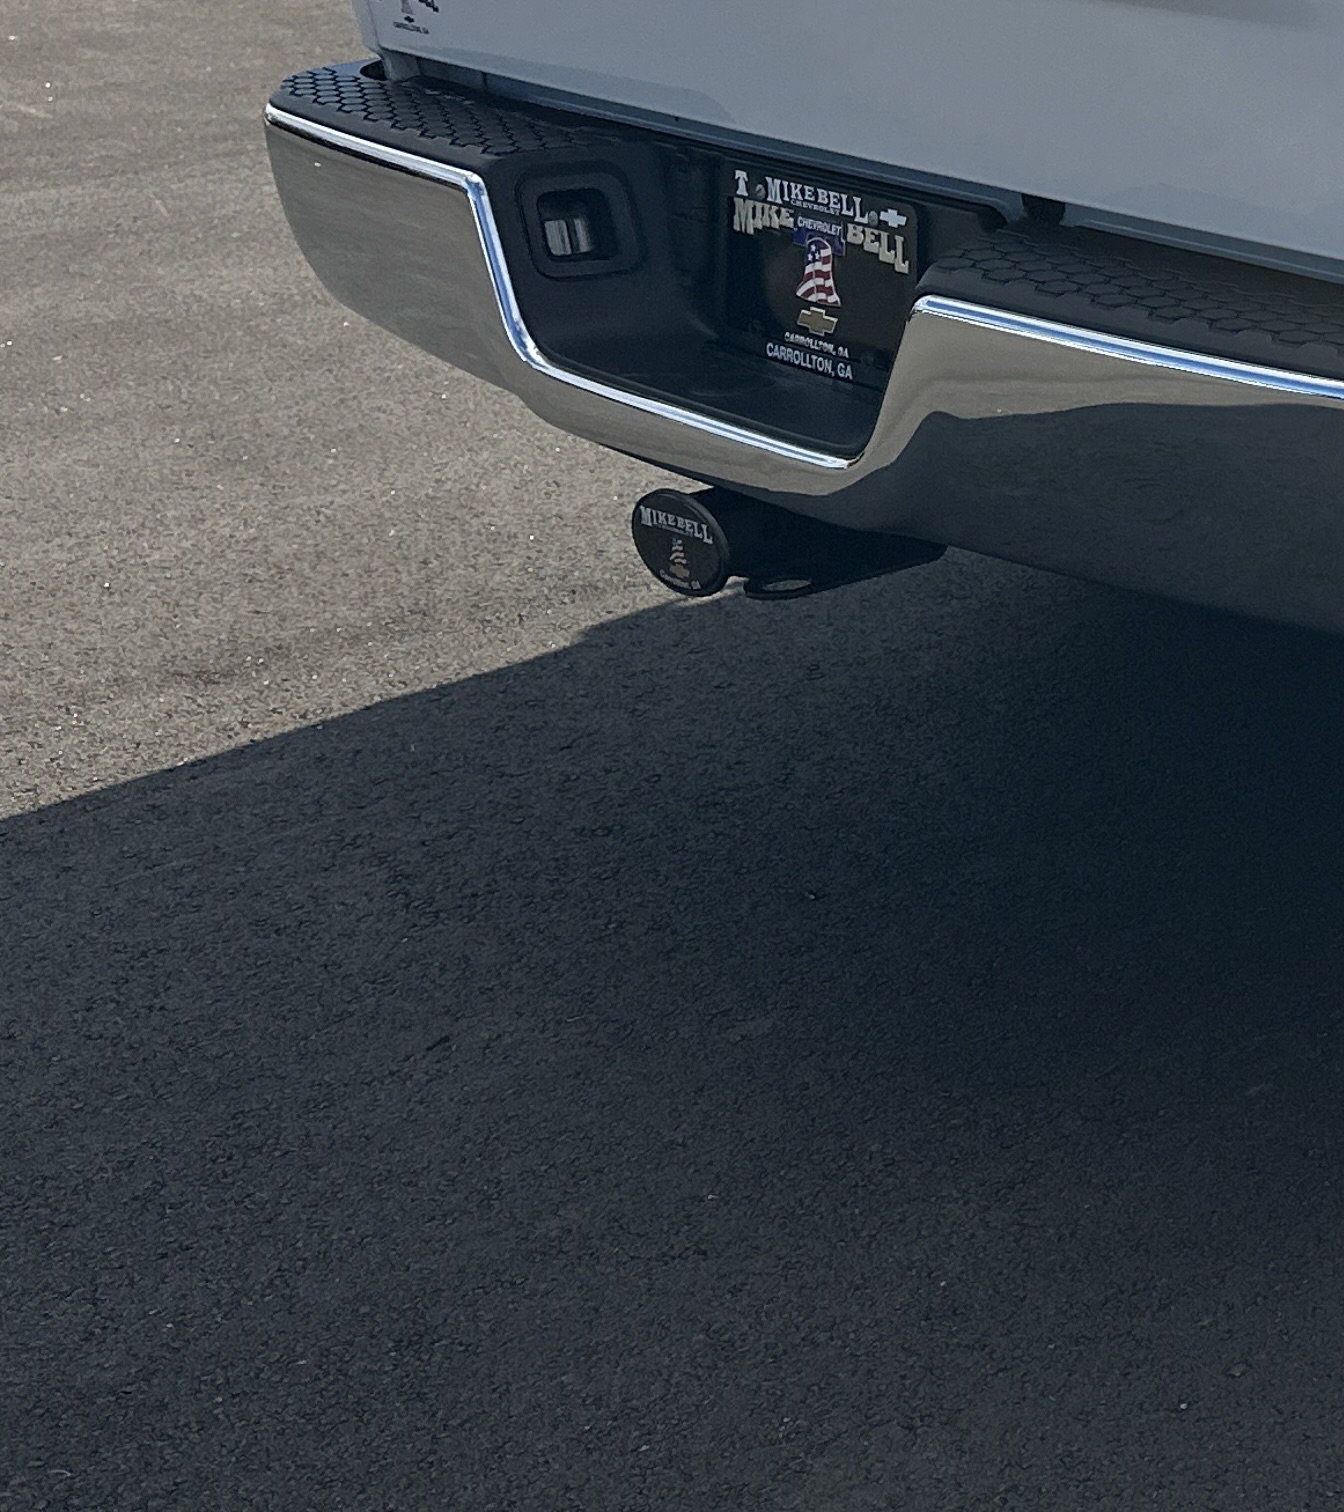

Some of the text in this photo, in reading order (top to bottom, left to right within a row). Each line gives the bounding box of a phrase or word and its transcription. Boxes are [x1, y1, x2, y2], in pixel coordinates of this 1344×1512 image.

[733, 197, 909, 274] MIKE BELL
[797, 216, 842, 236] CHEVROLET
[766, 342, 854, 380] CARROLLTON, GA
